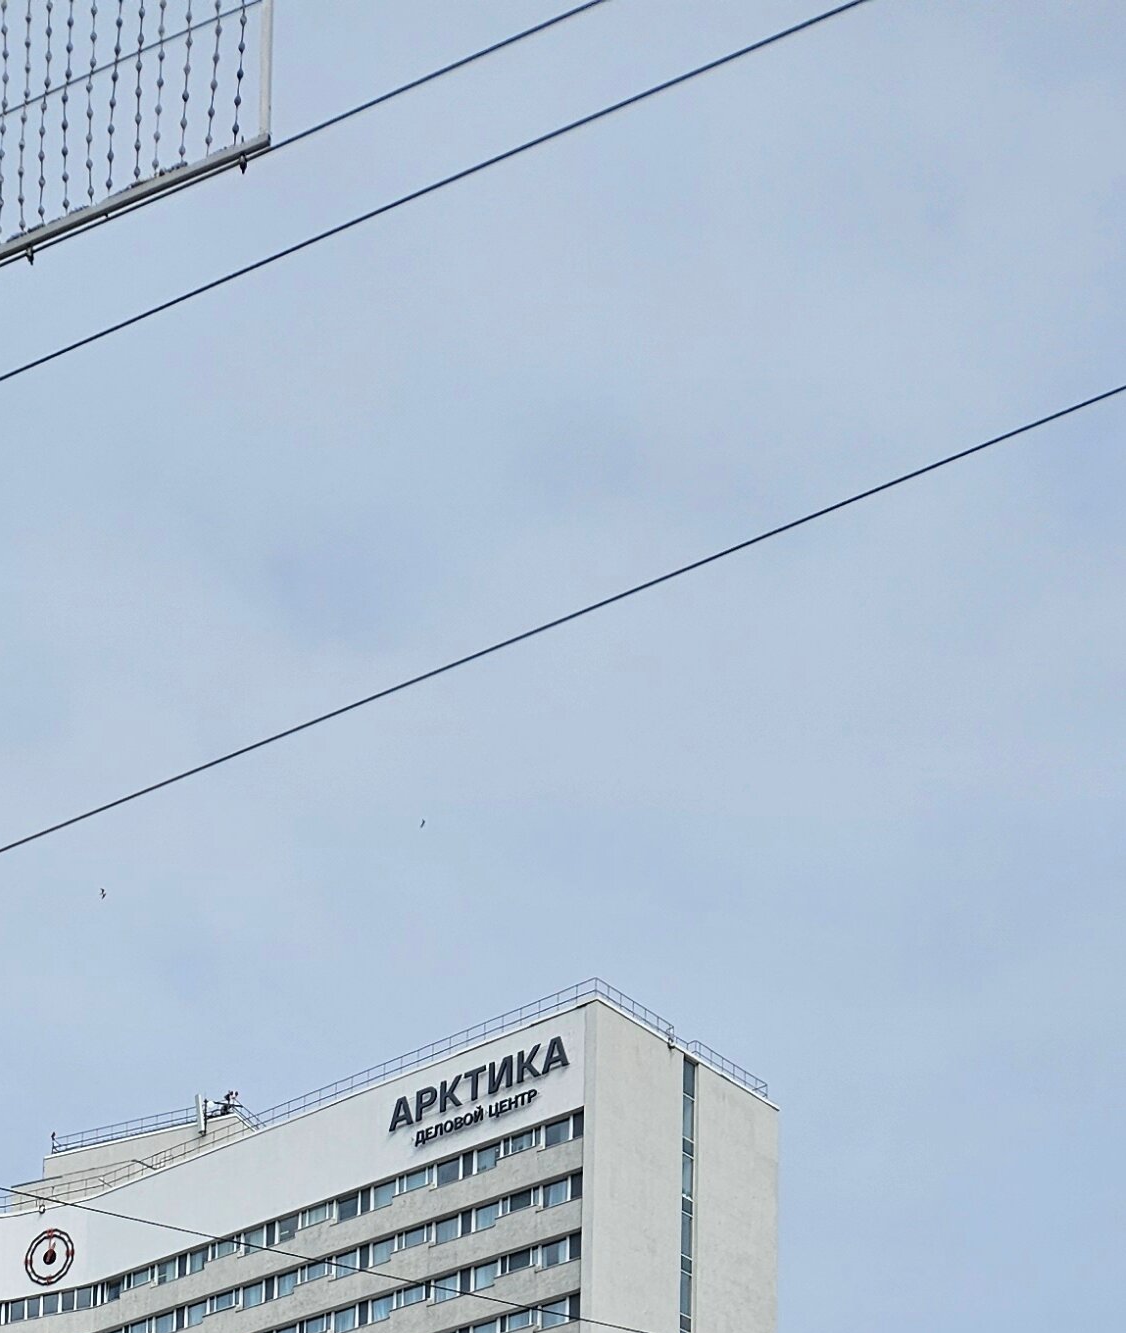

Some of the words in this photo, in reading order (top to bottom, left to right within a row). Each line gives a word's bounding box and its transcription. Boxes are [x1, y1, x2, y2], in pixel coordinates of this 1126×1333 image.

[389, 1035, 571, 1133] АРКТИКА
[414, 1105, 484, 1148] ДЕЛОВОЙ
[488, 1088, 538, 1118] ЦЕНТР
